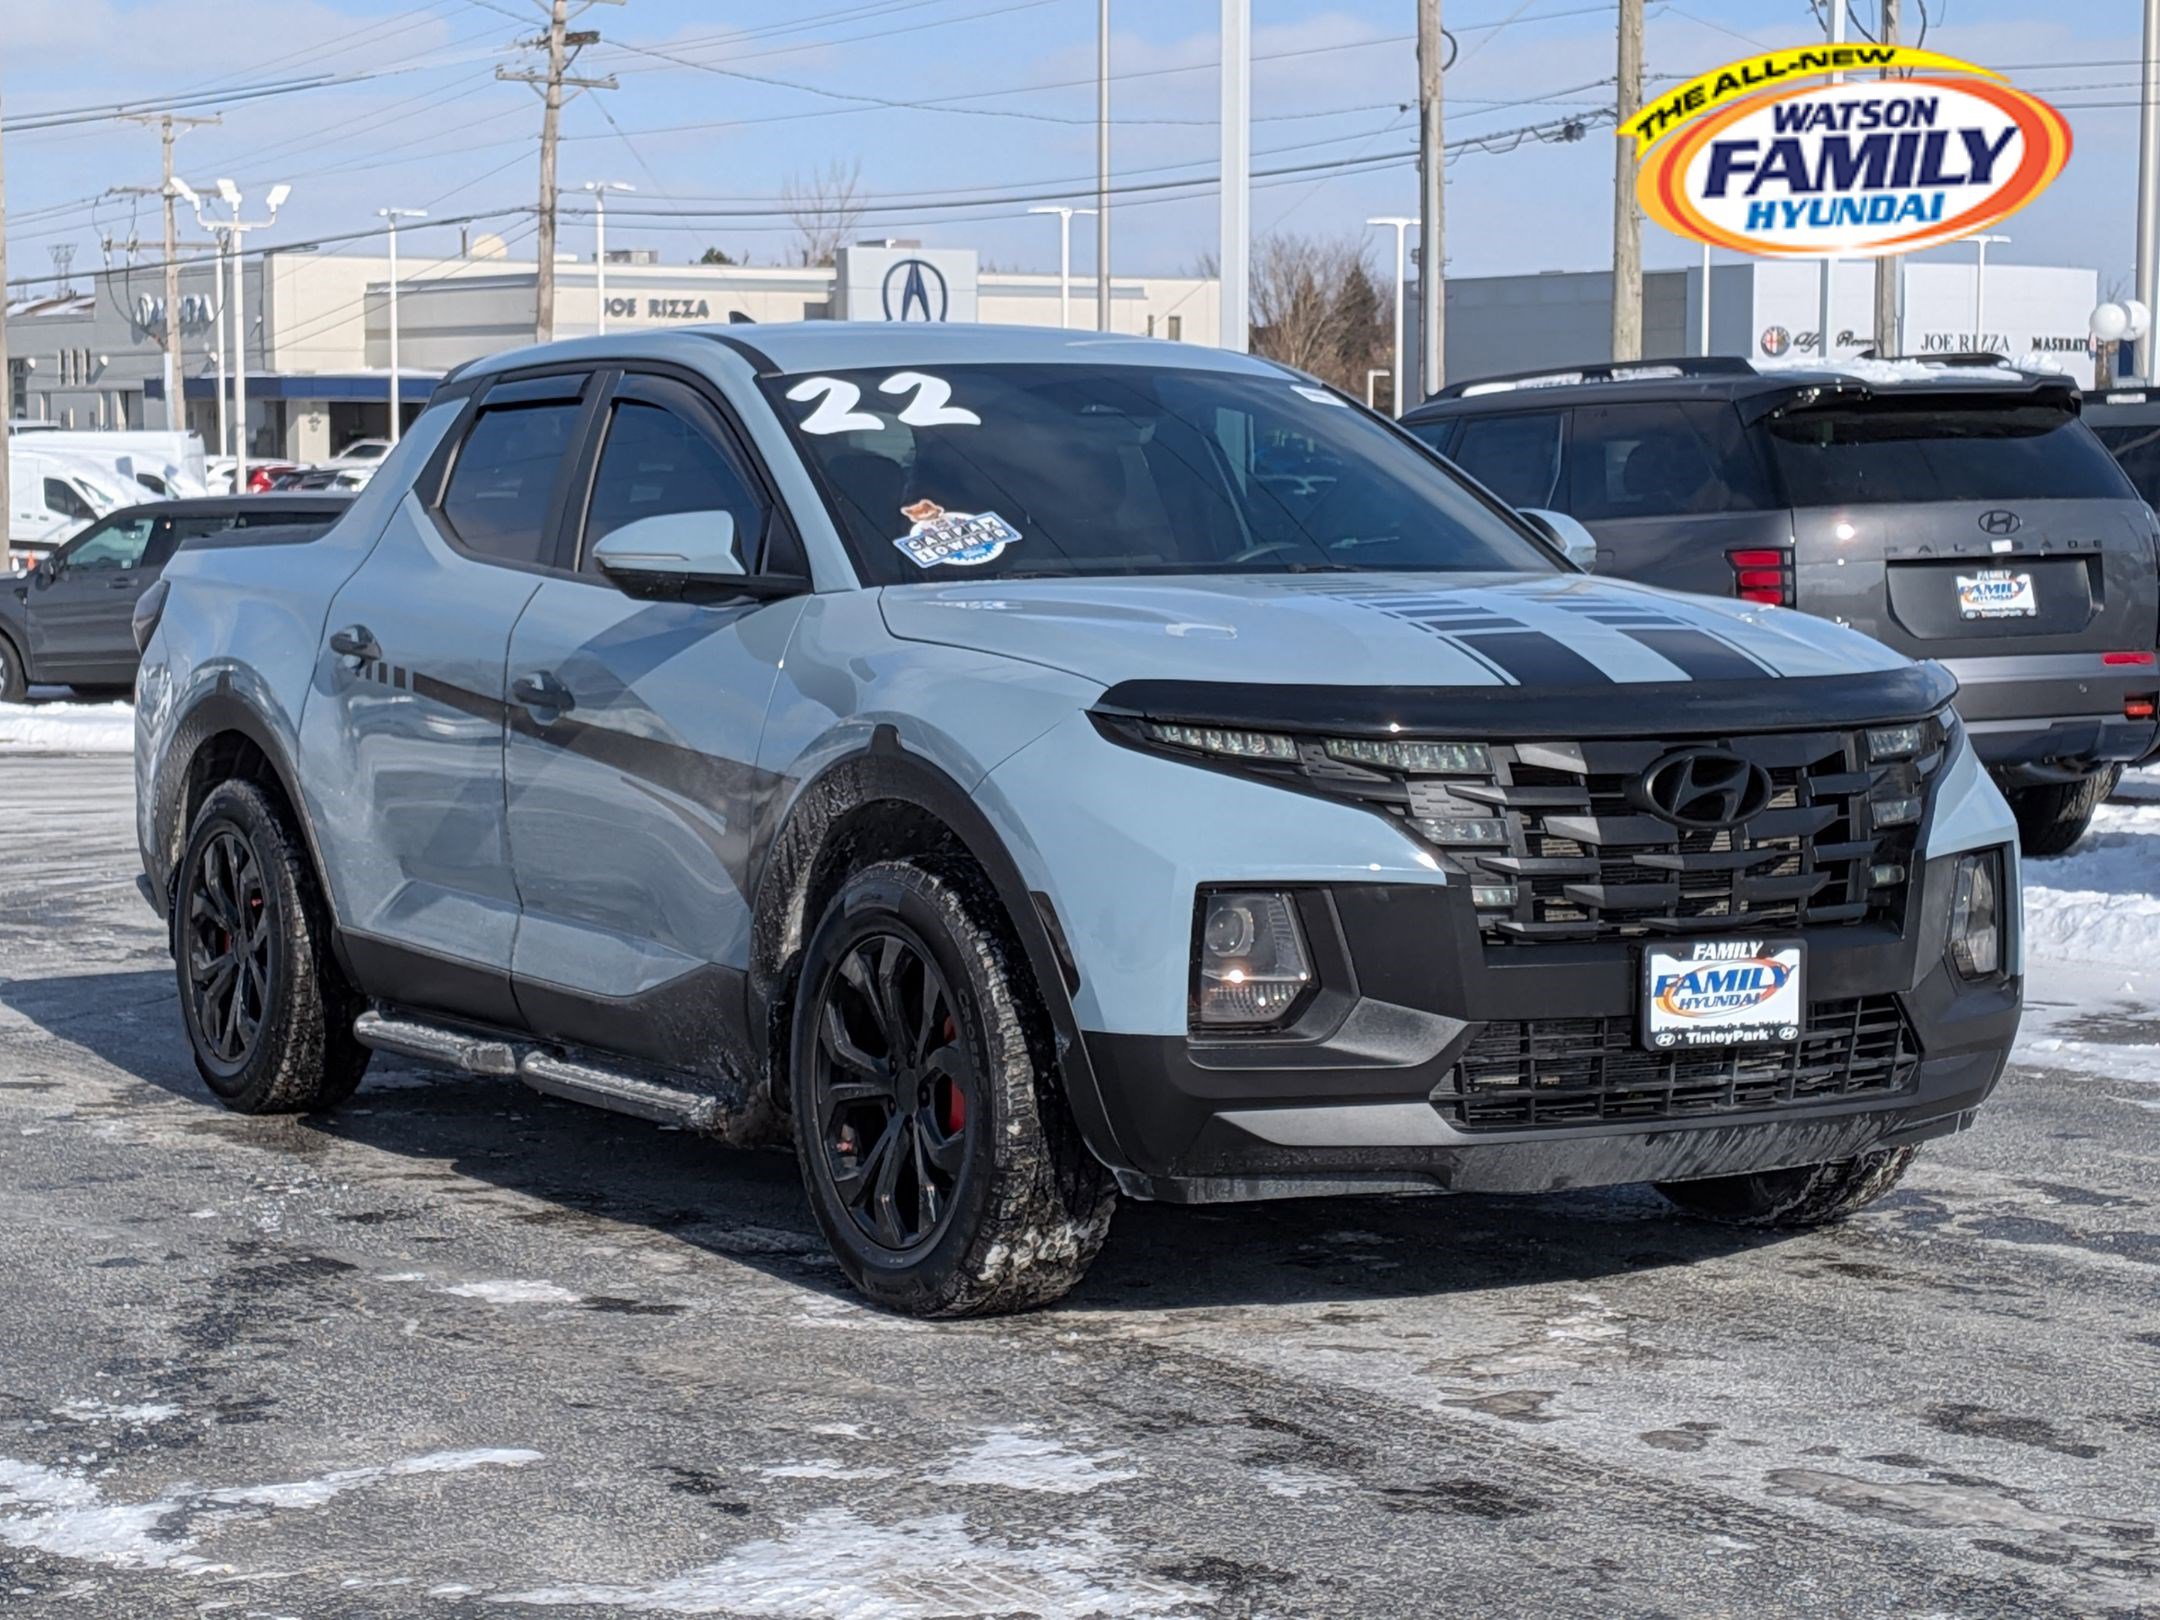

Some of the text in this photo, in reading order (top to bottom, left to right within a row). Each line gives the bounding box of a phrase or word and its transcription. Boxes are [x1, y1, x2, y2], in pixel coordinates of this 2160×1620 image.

[648, 298, 711, 319] RIZZA
[1920, 333, 2010, 353] JOE RIZZA
[908, 520, 1000, 550] CARFAX
[934, 528, 1009, 556] OWNER
[1692, 940, 1764, 961] FAMILY
[1653, 964, 1798, 998] FAMILY
[1678, 992, 1761, 1011] HYUNDAI
